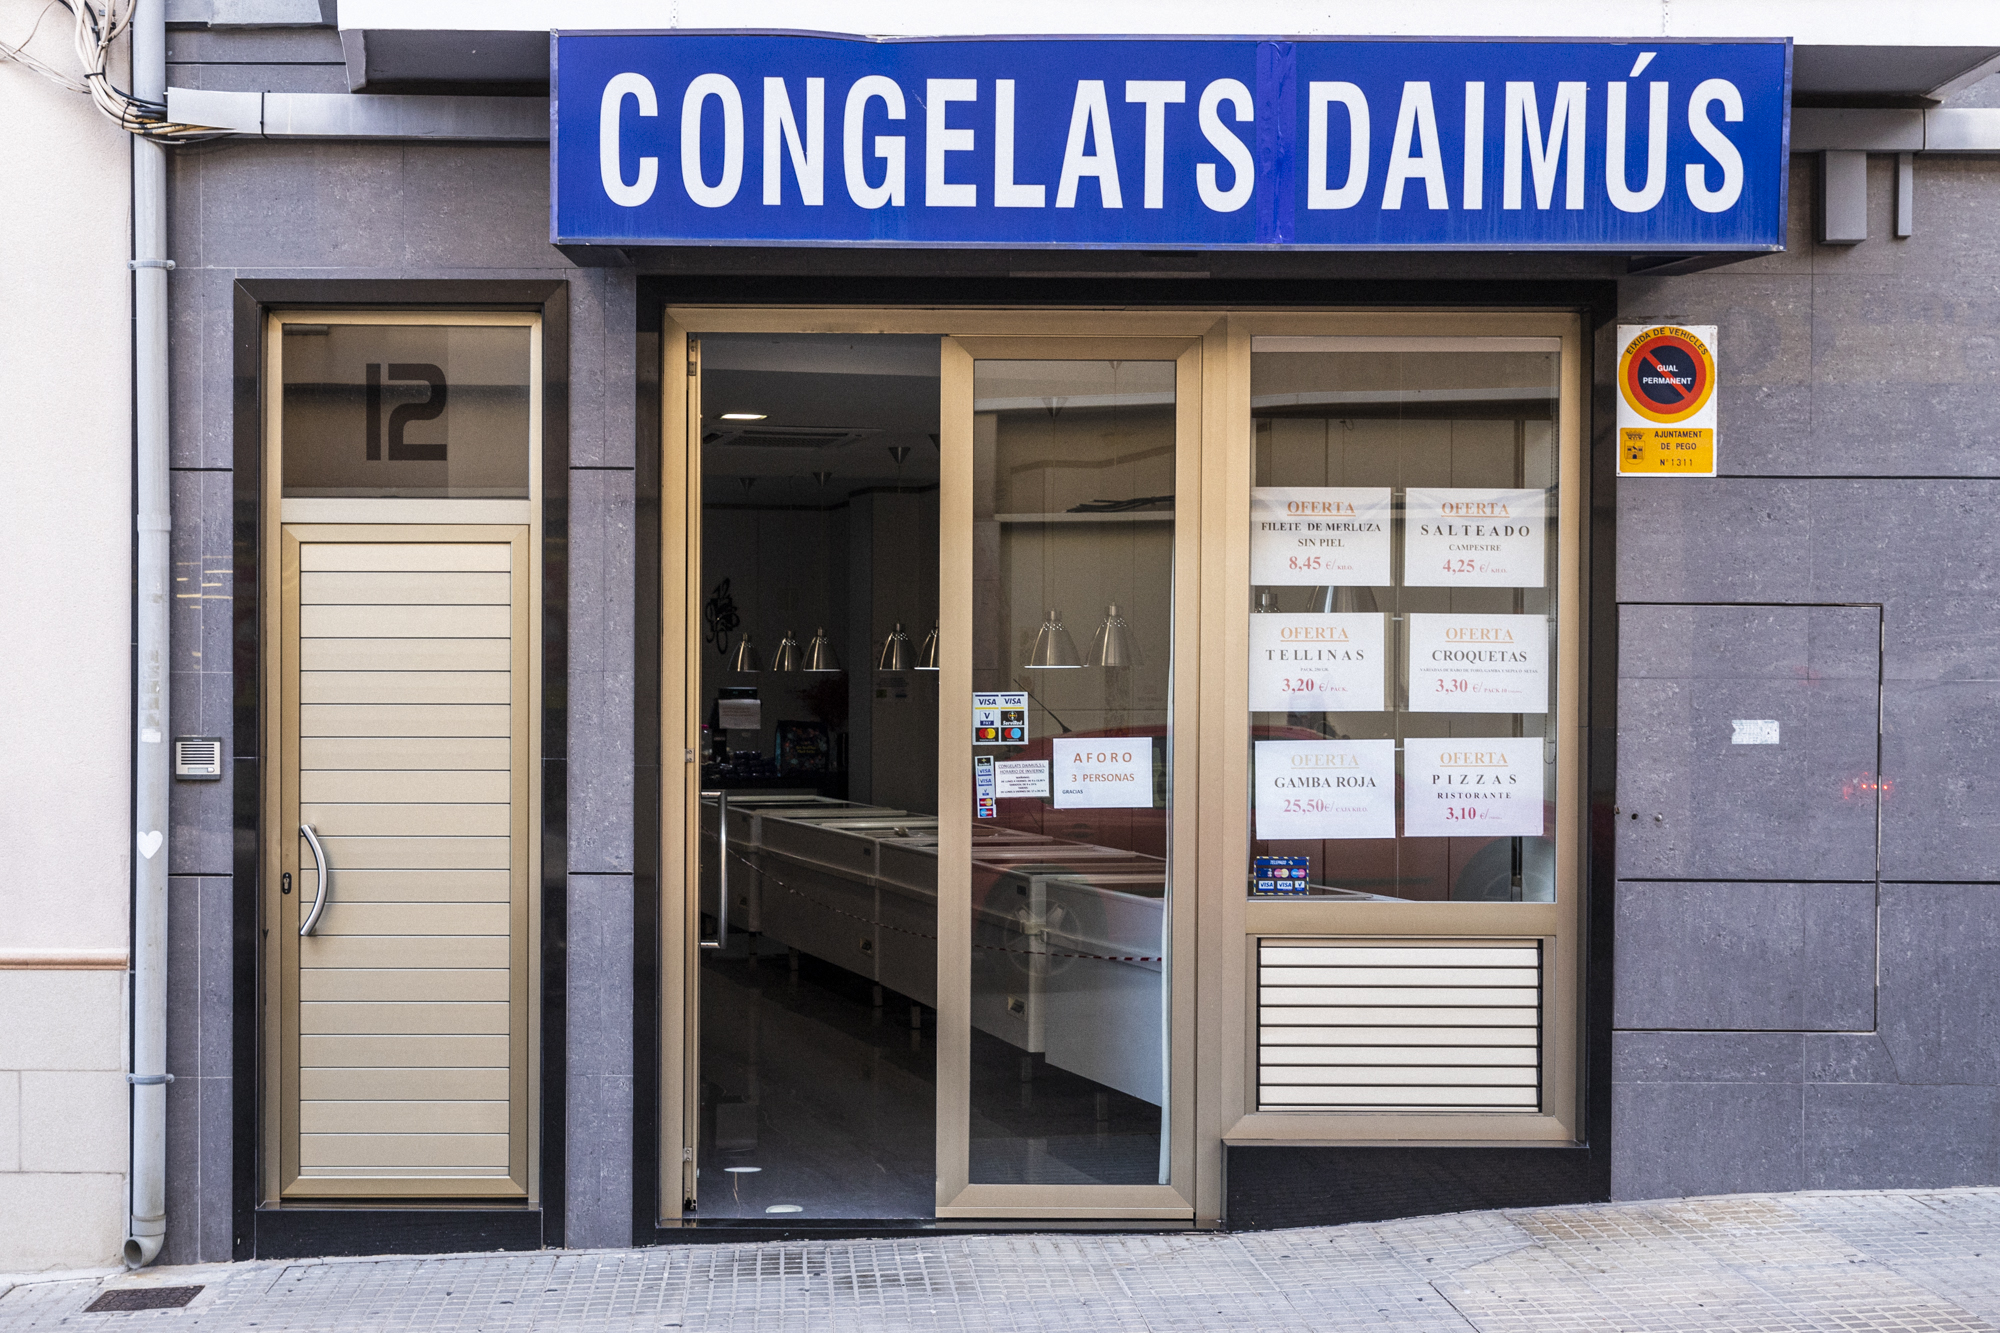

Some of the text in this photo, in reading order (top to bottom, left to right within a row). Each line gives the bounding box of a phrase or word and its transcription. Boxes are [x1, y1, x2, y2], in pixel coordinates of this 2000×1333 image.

[599, 51, 1745, 214] CONGELATS DAIMÚS
[1625, 327, 1709, 356] EIXIDA DE VEHICLES
[1656, 364, 1679, 372] GUAL
[1642, 376, 1692, 385] PERMANENT
[366, 363, 447, 461] 12
[1654, 430, 1703, 438] AJUNTAMENT
[1660, 442, 1697, 450] DE PEGO
[1287, 500, 1356, 515] OFERTA
[1441, 501, 1510, 516] OFERTA
[1261, 522, 1382, 533] FILETE DE MERLUZA
[1420, 524, 1530, 538] SALTEADO
[1297, 538, 1345, 548] SIN PIEL
[1448, 543, 1502, 552] CAMPESTRE
[1289, 555, 1322, 573] 8,45
[1442, 558, 1475, 576] 4,25
[1280, 626, 1350, 640] OFERTA
[1445, 627, 1514, 641] OFERTA
[1265, 649, 1365, 661] TELLINAS
[1431, 649, 1528, 664] CROQUETAS
[1282, 678, 1315, 695] 3,20
[1436, 678, 1468, 696] 3,30
[978, 698, 997, 706] VISA
[1003, 697, 1022, 705] VISA
[983, 712, 991, 720] V
[1073, 751, 1133, 764] AFORO
[1290, 753, 1360, 768] OFERTA
[1439, 751, 1509, 765] OFERTA
[1071, 772, 1135, 783] 3 PERSONAS
[1274, 776, 1377, 789] GAMBA ROJA
[1432, 774, 1517, 785] PIZZAS
[1437, 791, 1512, 800] RISTORANTE
[1446, 806, 1477, 822] 3,10
